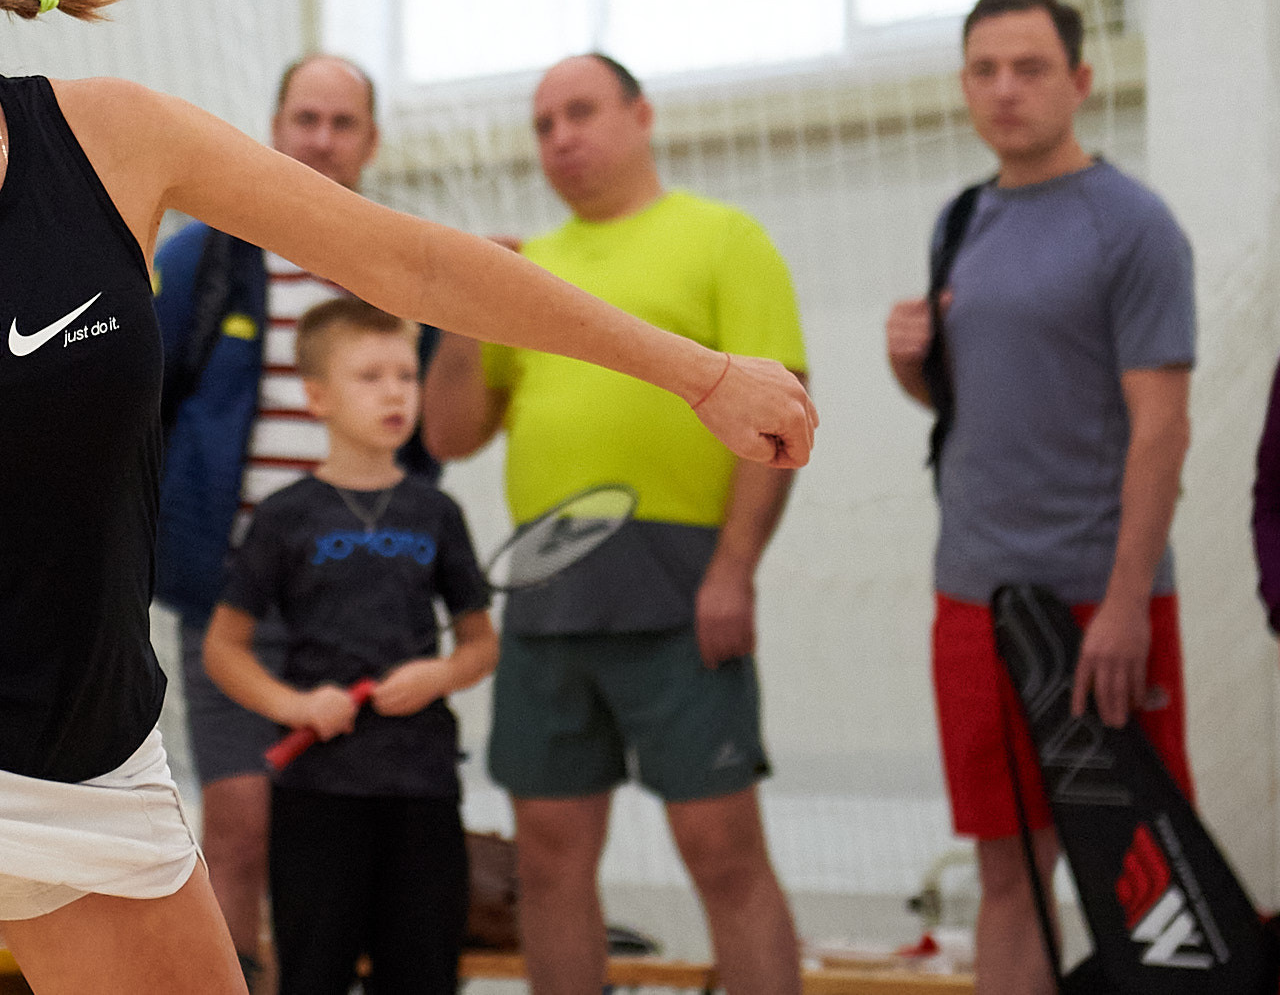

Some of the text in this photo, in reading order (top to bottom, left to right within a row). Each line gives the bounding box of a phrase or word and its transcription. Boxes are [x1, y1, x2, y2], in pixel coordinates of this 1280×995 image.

[63, 316, 121, 348] just do it.
